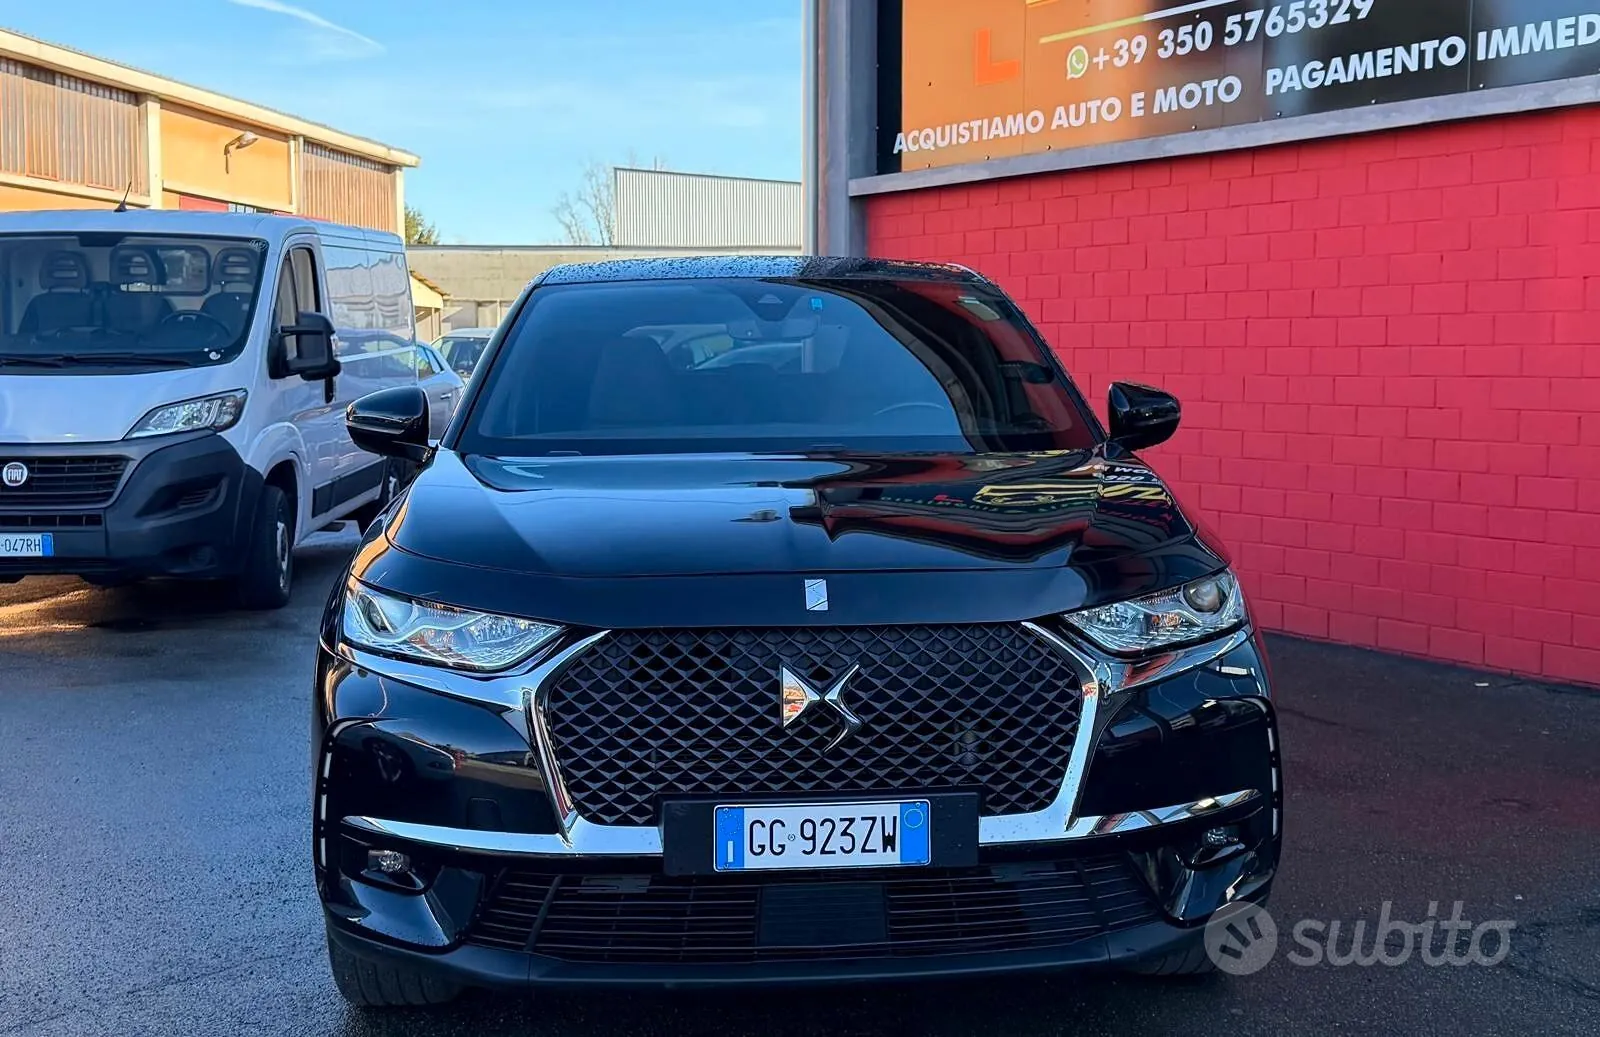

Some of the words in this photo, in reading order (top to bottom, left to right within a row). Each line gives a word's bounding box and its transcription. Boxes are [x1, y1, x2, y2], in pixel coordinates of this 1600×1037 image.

[1093, 35, 1147, 71] +39
[1158, 21, 1213, 59] 350
[1223, 0, 1374, 46] 5765329
[893, 110, 1044, 154] ACQUISTIAMO
[1051, 96, 1122, 130] AUTO
[1131, 92, 1146, 117] E
[1153, 75, 1242, 114] MOTO
[1265, 36, 1466, 95] PAGAMENTO
[1476, 13, 1600, 61] IMMED
[4, 538, 41, 553] 047RH
[749, 819, 786, 857] GG
[800, 815, 898, 856] 923ZW
